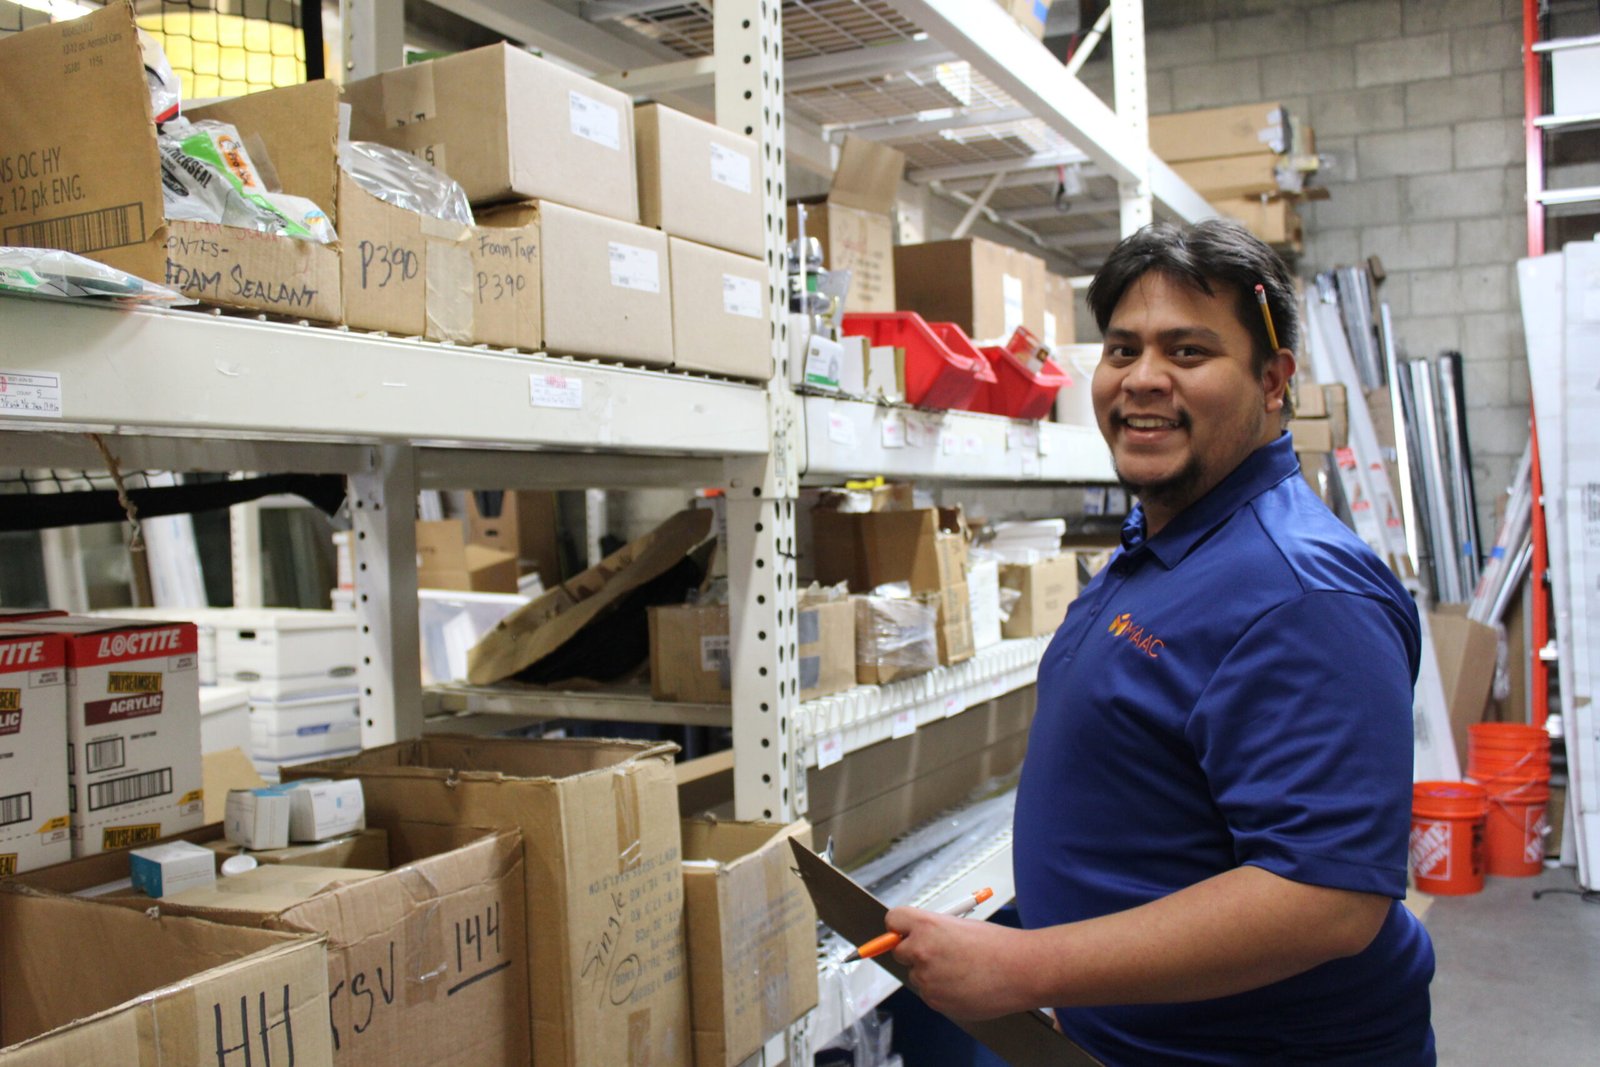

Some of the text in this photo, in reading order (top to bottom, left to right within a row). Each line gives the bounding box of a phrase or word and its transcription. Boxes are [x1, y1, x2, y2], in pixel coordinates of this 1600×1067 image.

[18, 152, 38, 180] QC
[42, 146, 61, 175] HY
[12, 186, 27, 212] 12
[31, 180, 48, 216] pk
[52, 174, 86, 205] ENG.
[478, 234, 512, 258] Foam
[358, 239, 419, 290] P390
[165, 257, 318, 308] FOAM SEALANT
[476, 271, 526, 304] P390
[97, 628, 181, 659] LOCTITE
[108, 694, 162, 715] ACRYLIC
[455, 901, 501, 973] 144
